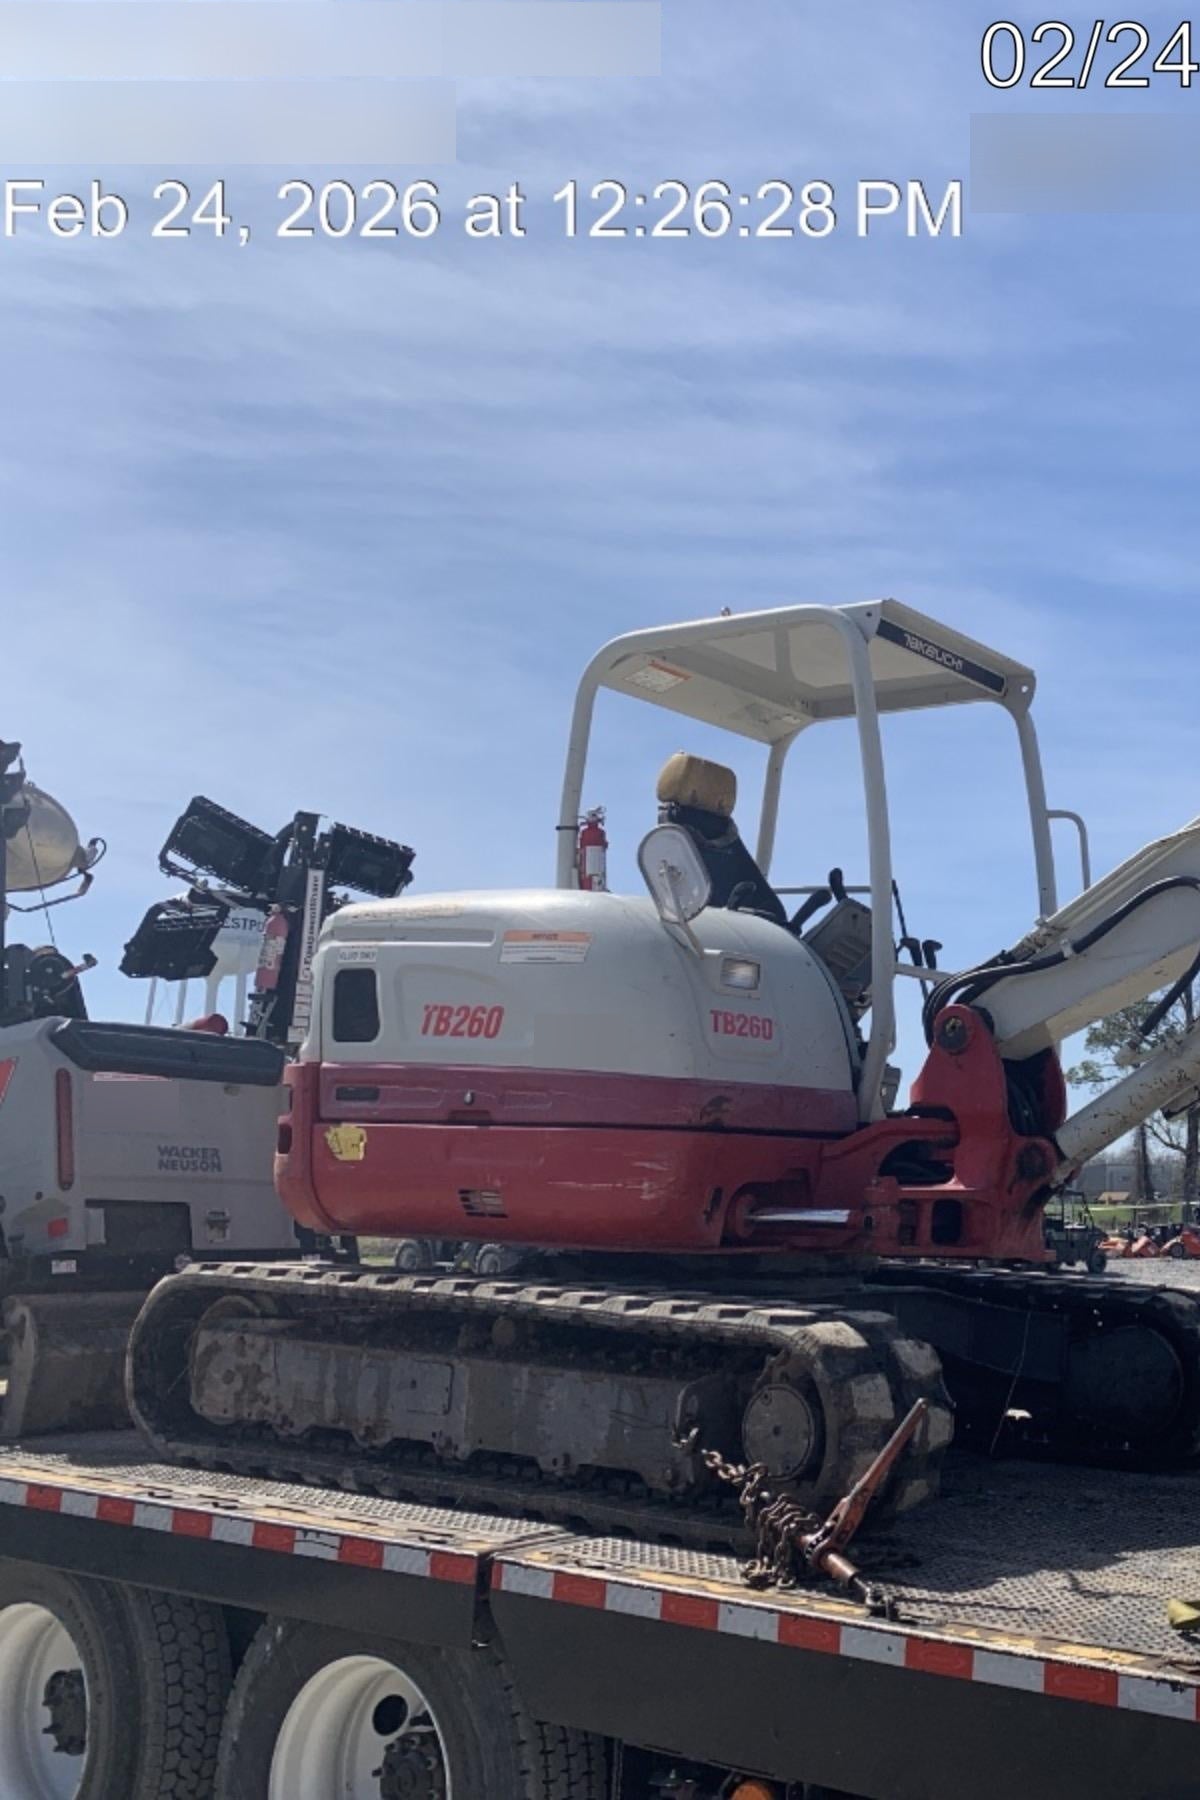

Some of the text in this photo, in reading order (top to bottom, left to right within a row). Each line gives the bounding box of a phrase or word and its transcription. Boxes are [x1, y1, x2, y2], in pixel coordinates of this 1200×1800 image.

[421, 1004, 505, 1039] TB260
[709, 1009, 773, 1040] TB260
[157, 1145, 221, 1160] WACKER
[157, 1159, 222, 1172] NEUSON
